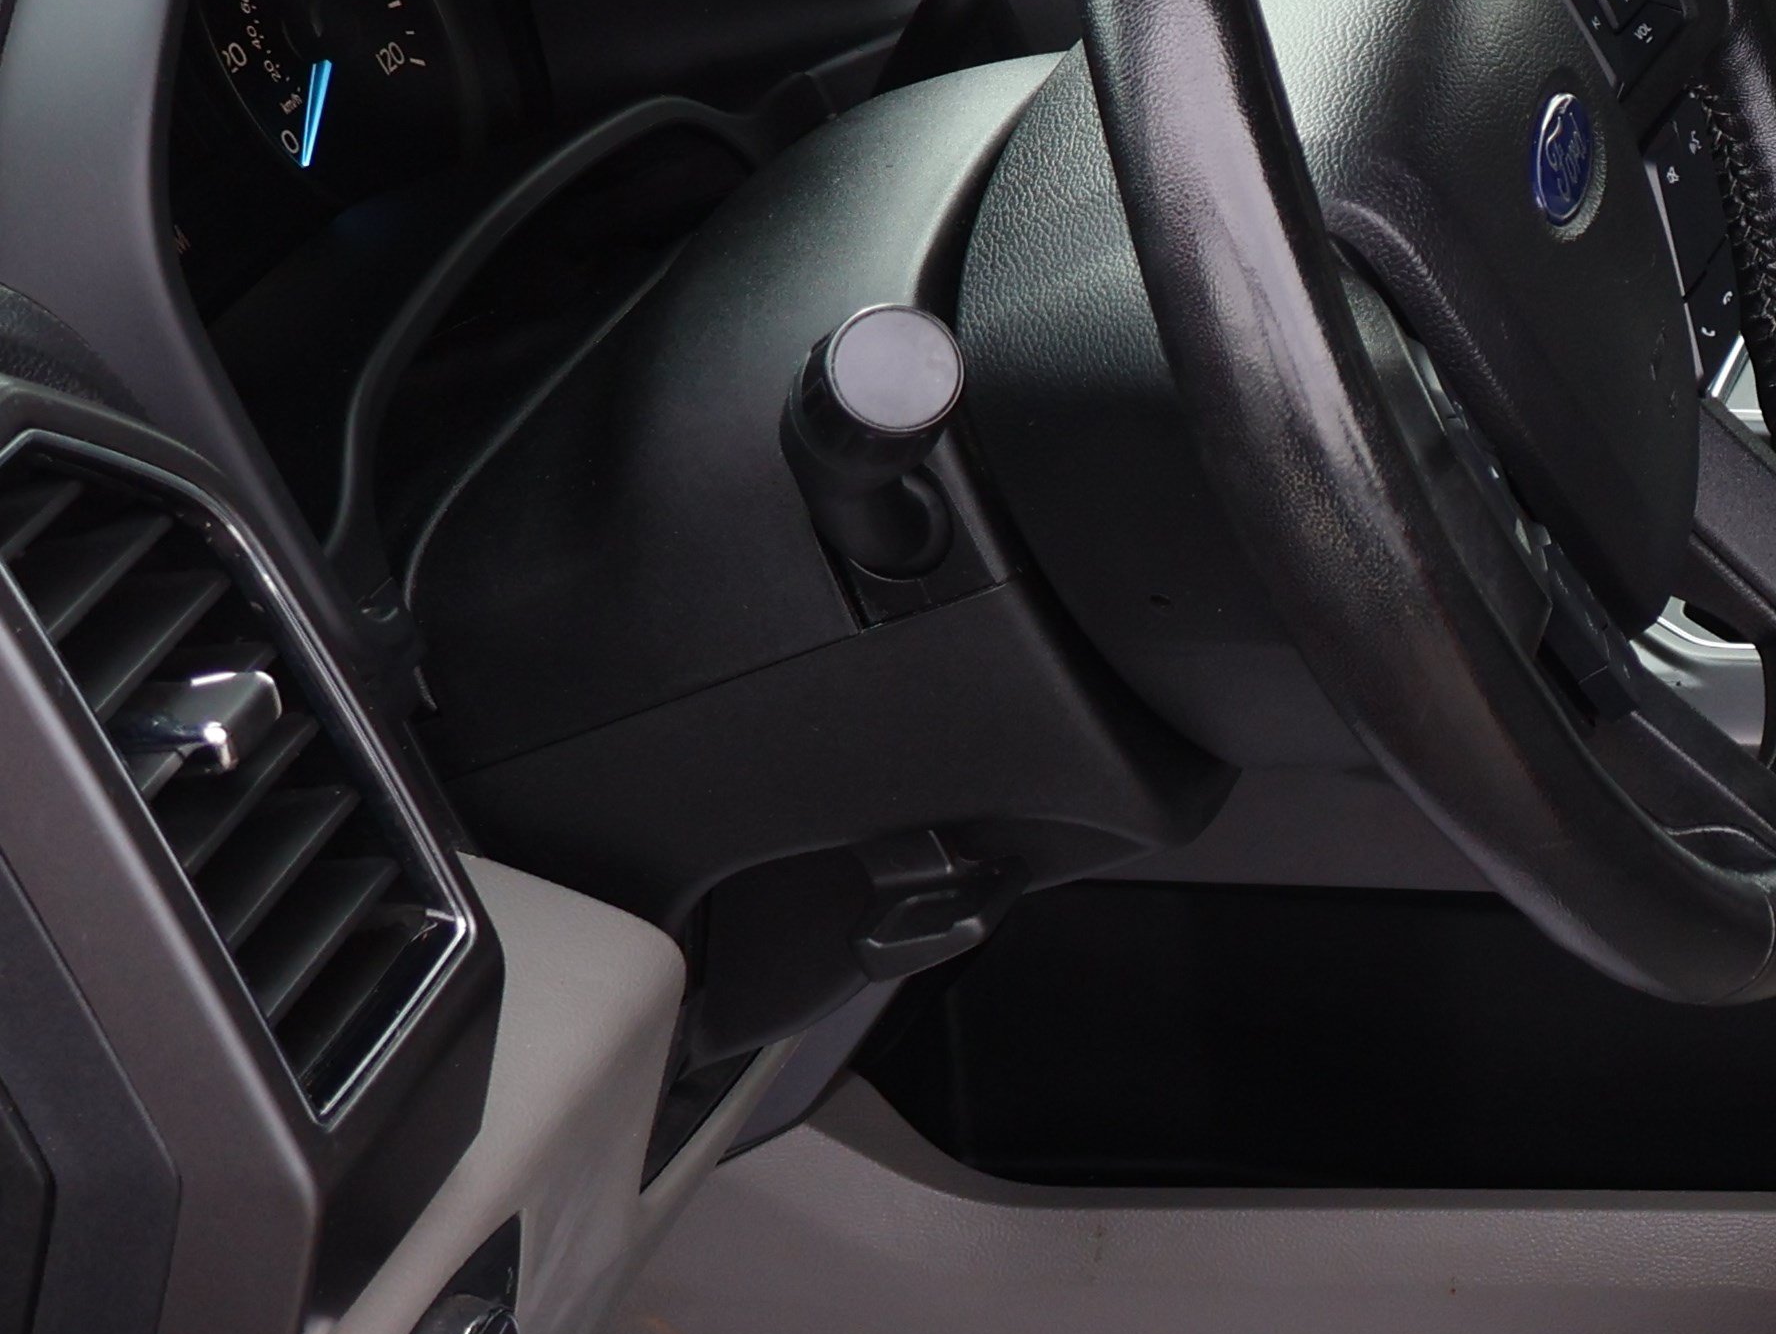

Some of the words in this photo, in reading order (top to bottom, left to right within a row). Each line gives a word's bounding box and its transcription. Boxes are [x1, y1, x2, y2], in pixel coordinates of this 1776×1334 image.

[1634, 22, 1652, 41] VOL
[376, 42, 406, 75] 120
[1546, 111, 1588, 203] Ford
